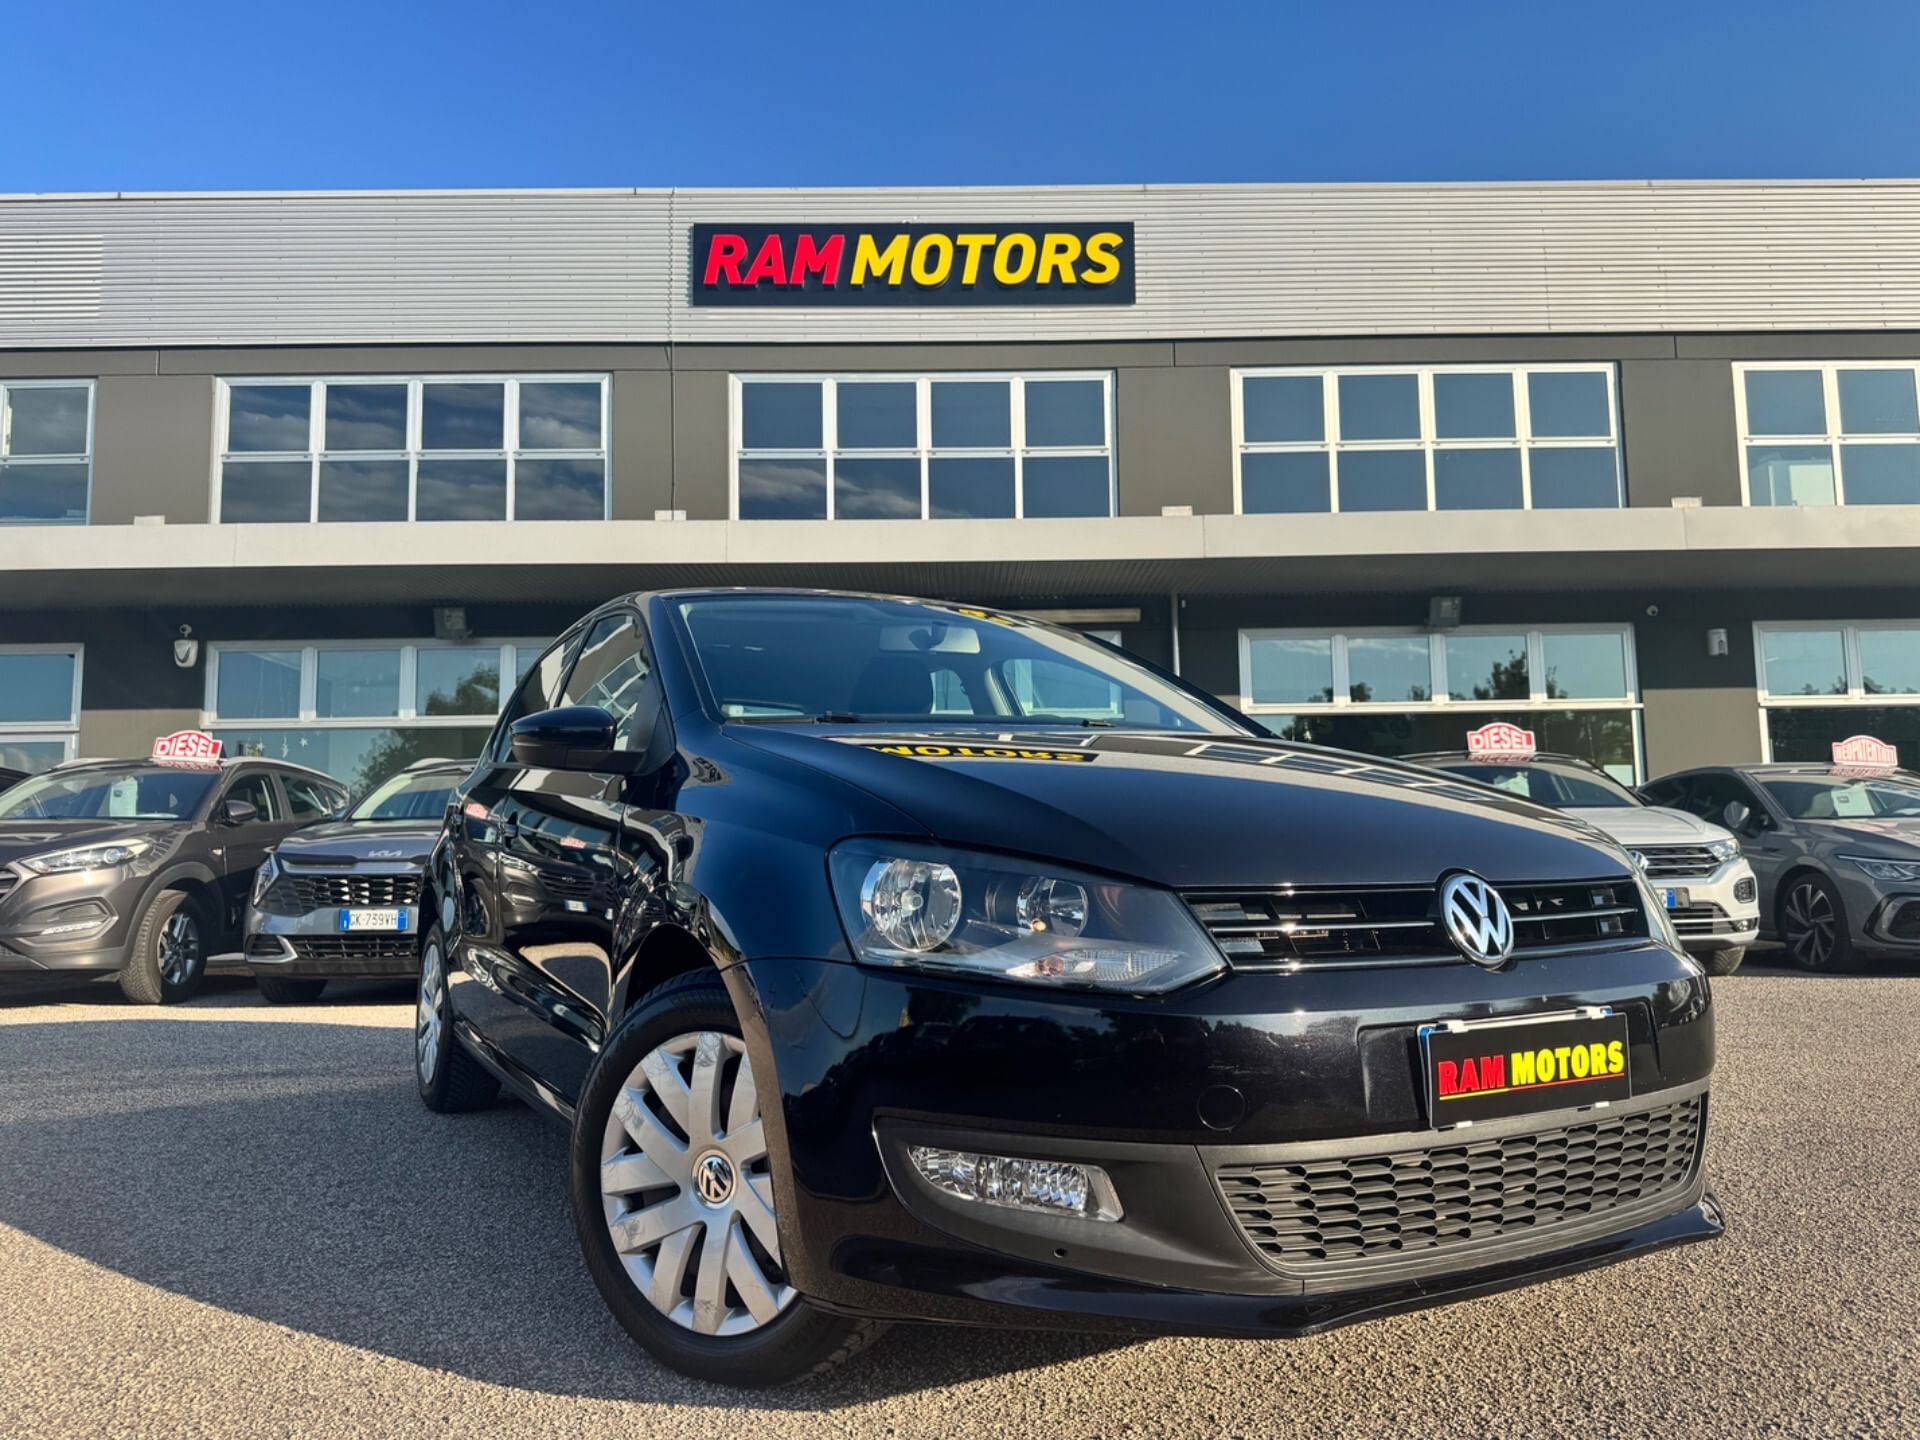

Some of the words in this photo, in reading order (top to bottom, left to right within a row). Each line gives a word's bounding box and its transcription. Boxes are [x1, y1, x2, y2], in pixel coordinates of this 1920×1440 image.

[703, 233, 845, 286] RAM
[850, 232, 1124, 286] MOTORS
[156, 734, 217, 758] DIESEL
[1470, 726, 1533, 750] DIESEL
[1438, 1055, 1505, 1096] RAM
[1511, 1040, 1625, 1086] MOTORS
